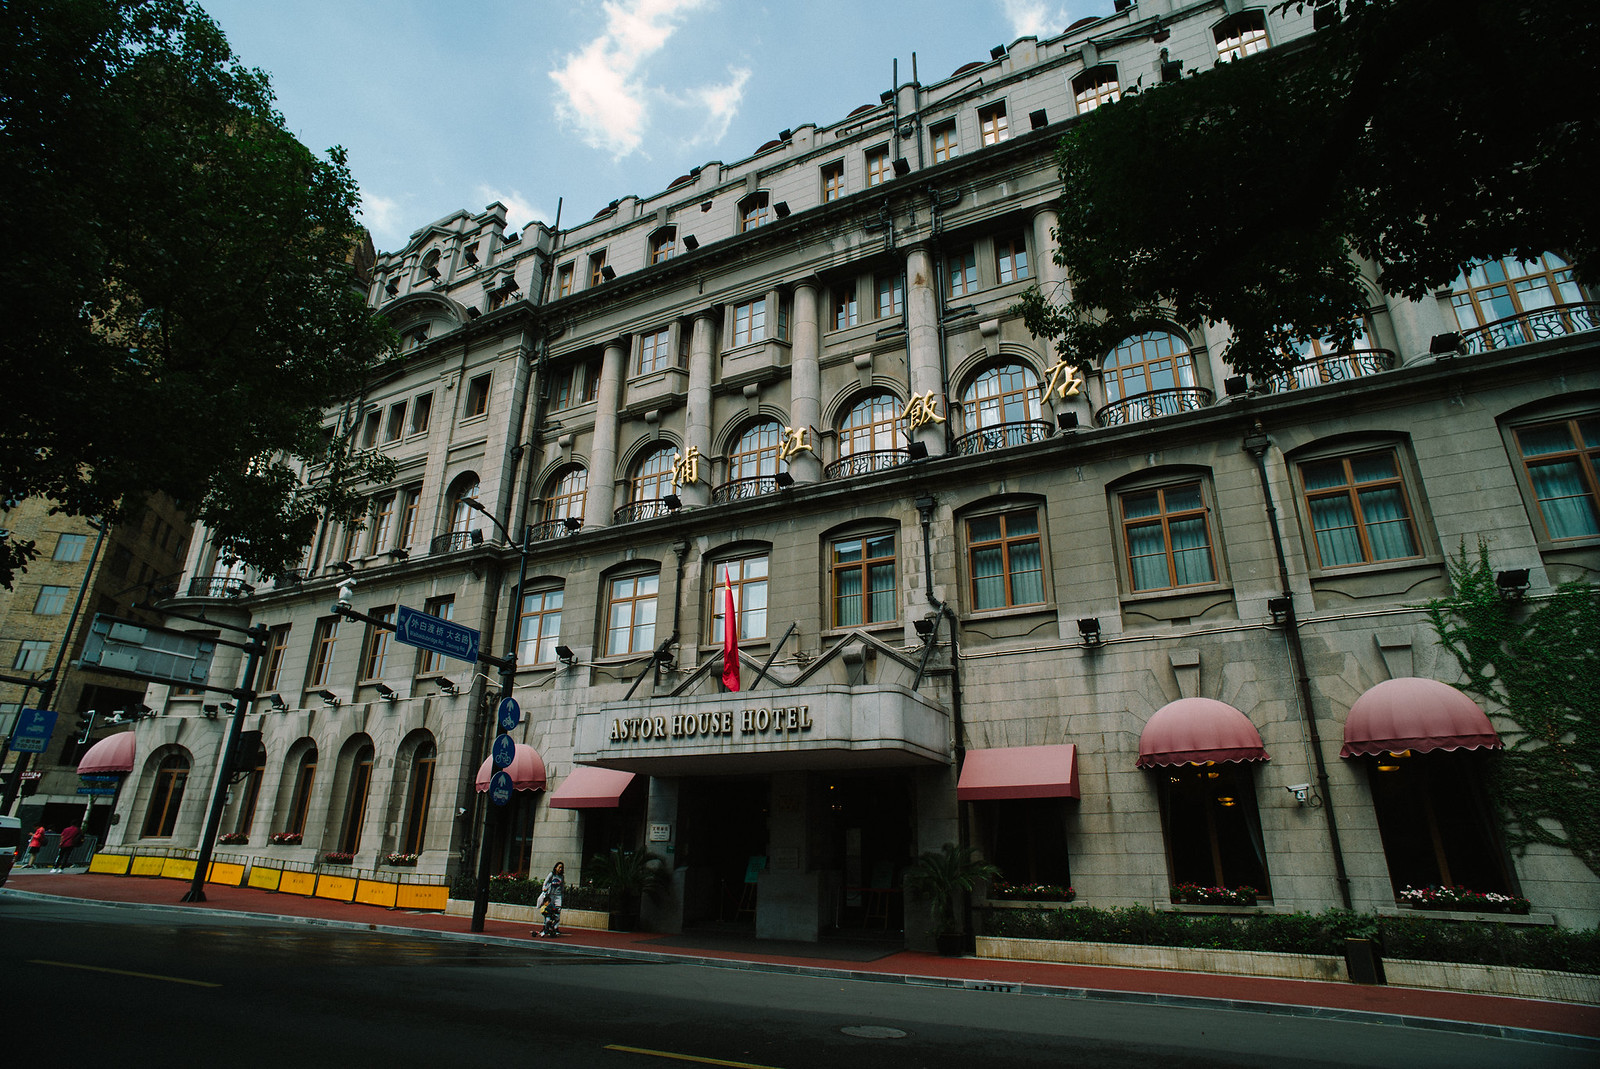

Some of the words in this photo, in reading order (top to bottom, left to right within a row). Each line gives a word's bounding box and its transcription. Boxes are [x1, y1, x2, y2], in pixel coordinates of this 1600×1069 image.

[671, 354, 1082, 486] 浦江飯店
[411, 618, 444, 637] 外白渡桥
[446, 629, 469, 645] 大名路
[609, 716, 667, 741] ASTOR
[671, 711, 734, 737] HOUSE
[740, 705, 813, 736] HOTEL
